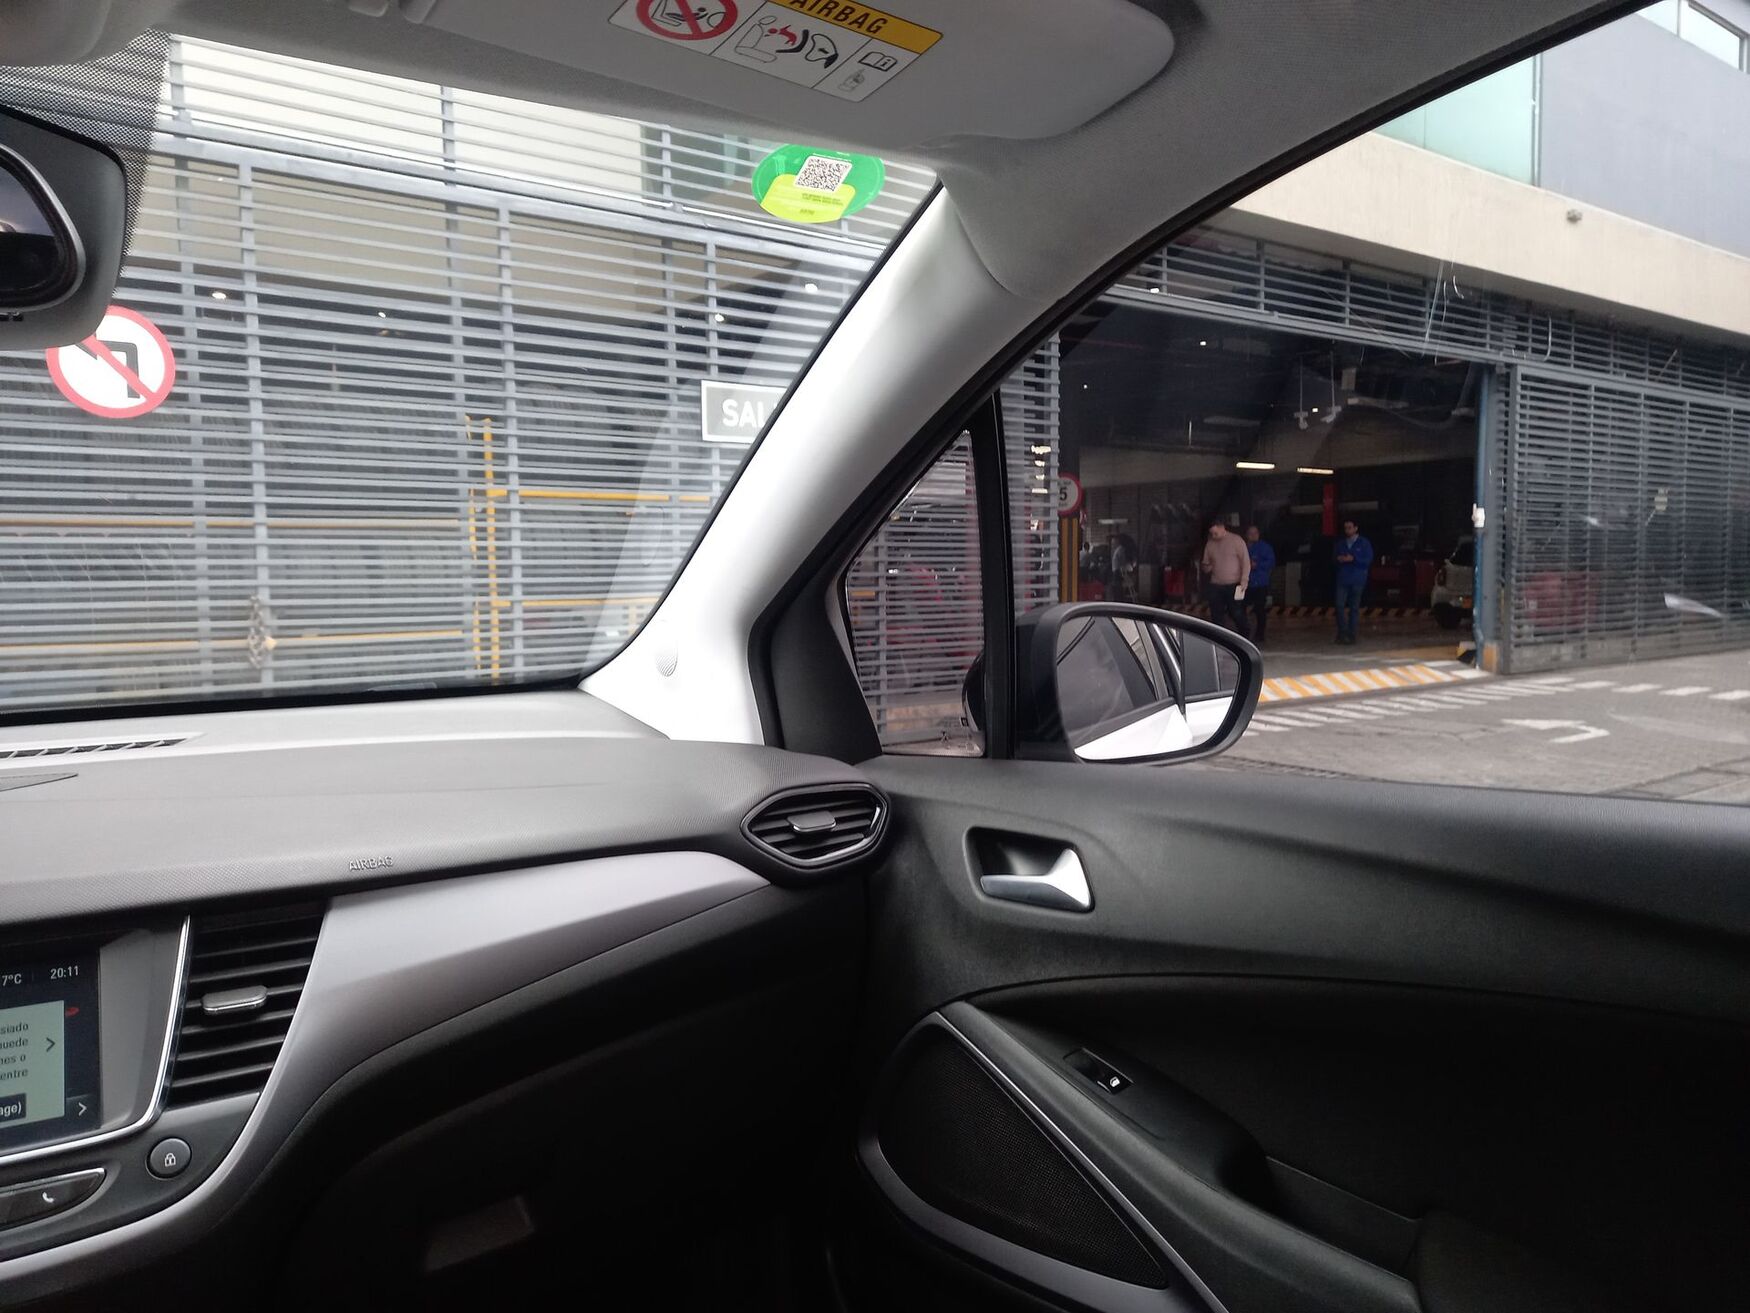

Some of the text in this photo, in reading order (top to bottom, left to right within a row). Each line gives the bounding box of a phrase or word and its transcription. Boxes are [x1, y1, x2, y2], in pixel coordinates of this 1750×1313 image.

[722, 399, 778, 428] SAL
[350, 856, 393, 870] AIRBAG
[50, 965, 79, 980] 20:11
[20, 1054, 26, 1062] o
